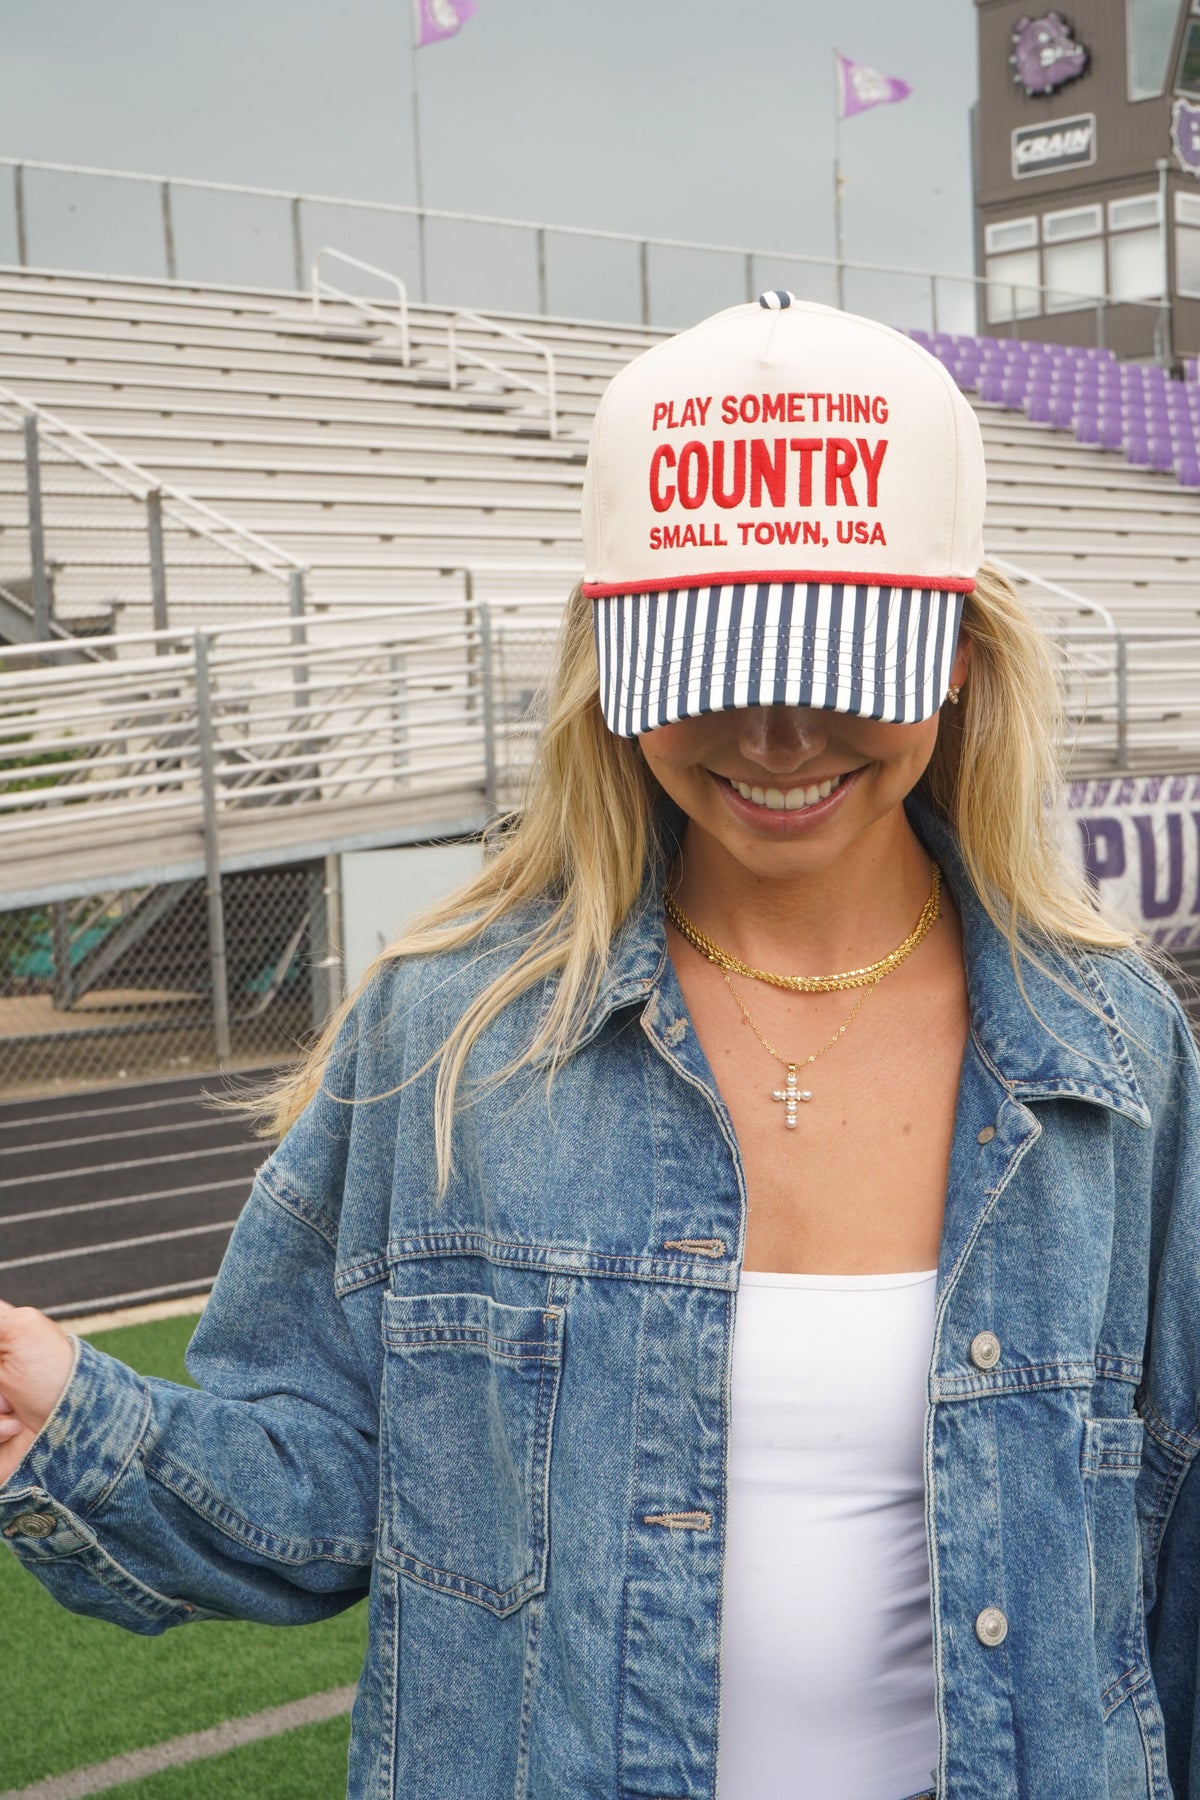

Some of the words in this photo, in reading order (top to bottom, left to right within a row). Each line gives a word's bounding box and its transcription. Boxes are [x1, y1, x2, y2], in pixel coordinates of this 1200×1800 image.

[1015, 127, 1091, 165] CRAIN
[652, 396, 712, 431] PLAY
[721, 392, 889, 425] SOMETHING
[649, 437, 888, 513] COUNTRY
[649, 523, 728, 550] SMALL
[737, 520, 829, 548] TOWN,
[836, 520, 887, 546] USA
[1077, 811, 1200, 919] PU
